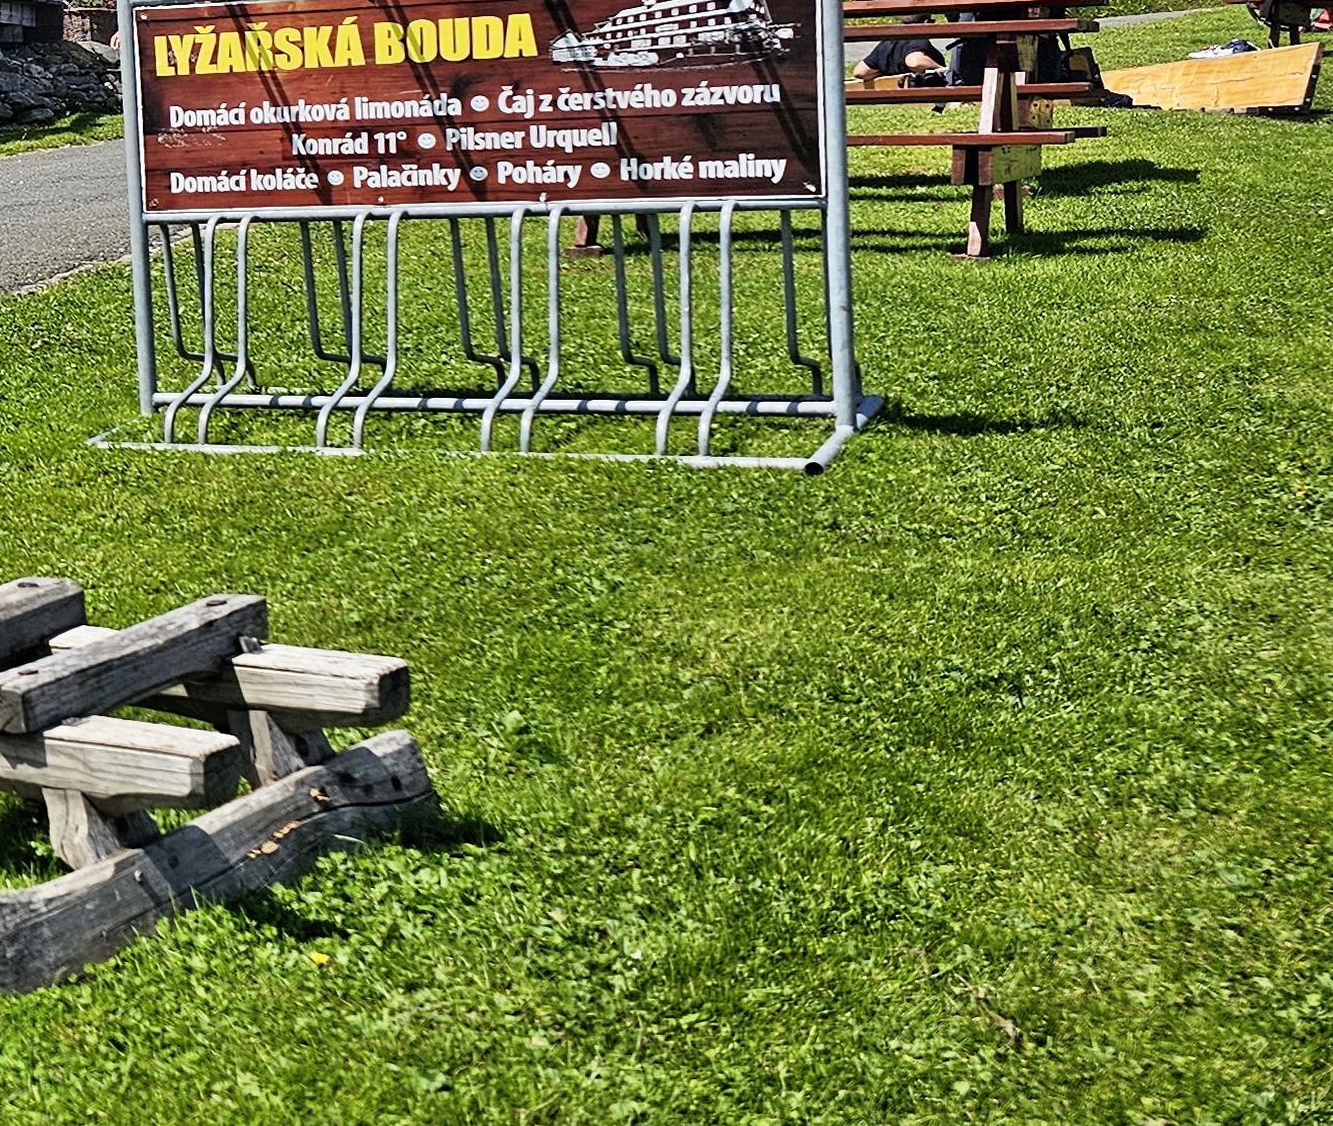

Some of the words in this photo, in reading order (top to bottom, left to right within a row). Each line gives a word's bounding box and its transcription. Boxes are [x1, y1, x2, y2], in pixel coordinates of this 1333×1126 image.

[154, 16, 366, 77] LYŽAŘSKÁ
[374, 13, 538, 65] BOUDA
[169, 102, 245, 128] Domácí
[250, 98, 350, 124] okurková
[355, 93, 462, 120] limonáda
[498, 85, 534, 119] Čaj
[538, 93, 553, 113] z
[557, 83, 677, 111] čerstvého
[681, 80, 781, 107] zázvoru
[291, 131, 368, 156] Konrád
[373, 130, 408, 155] 11°
[445, 126, 526, 152] Pilsner
[529, 121, 618, 154] Urquell
[170, 169, 246, 194] Domácí
[250, 168, 319, 192] koláče
[353, 162, 462, 192] Palačinky
[497, 159, 582, 189] Poháry
[619, 155, 694, 182] Horké
[698, 152, 788, 184] maliny
